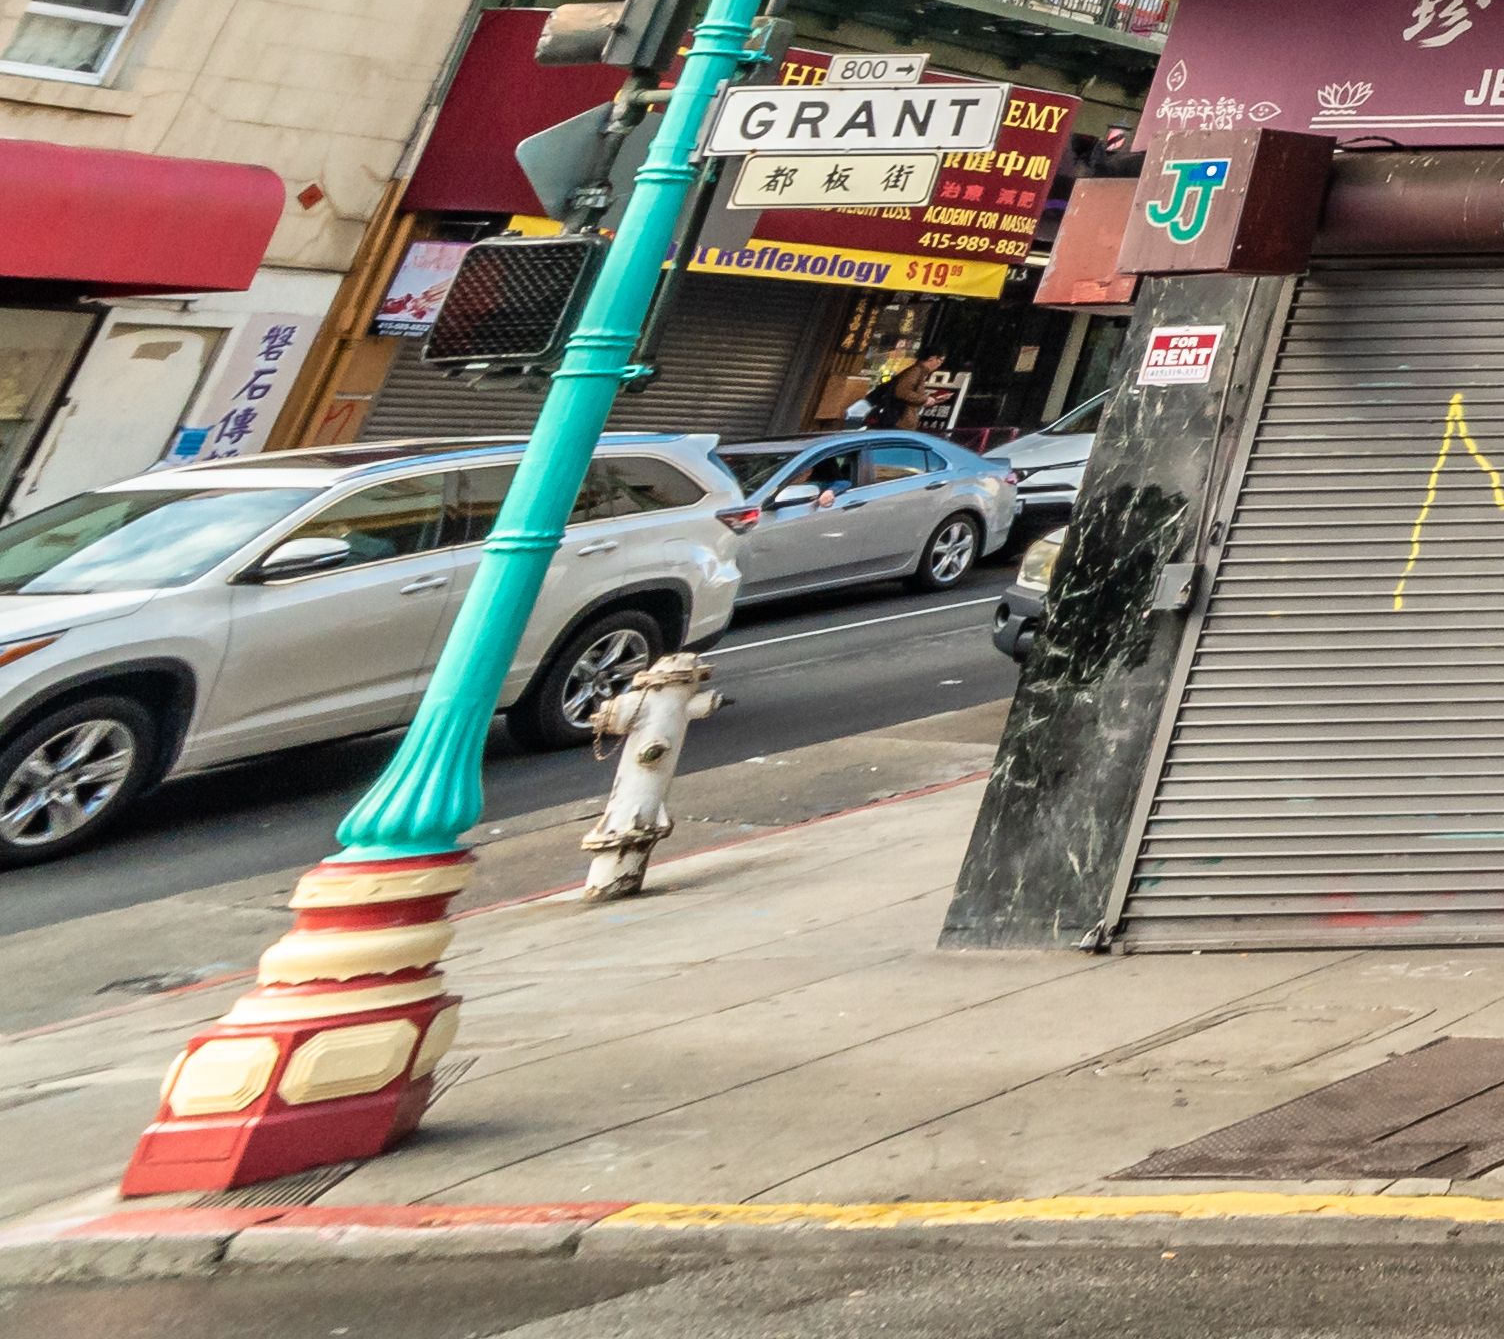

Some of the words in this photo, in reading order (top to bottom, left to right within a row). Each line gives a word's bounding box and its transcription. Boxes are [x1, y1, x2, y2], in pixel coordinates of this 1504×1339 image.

[840, 59, 890, 81] 800
[740, 97, 982, 141] GRANT
[759, 164, 917, 194] 都板街
[922, 206, 977, 227] ACADEMY
[976, 211, 998, 231] FOR
[1169, 336, 1199, 348] FOR
[1148, 348, 1212, 365] RENT
